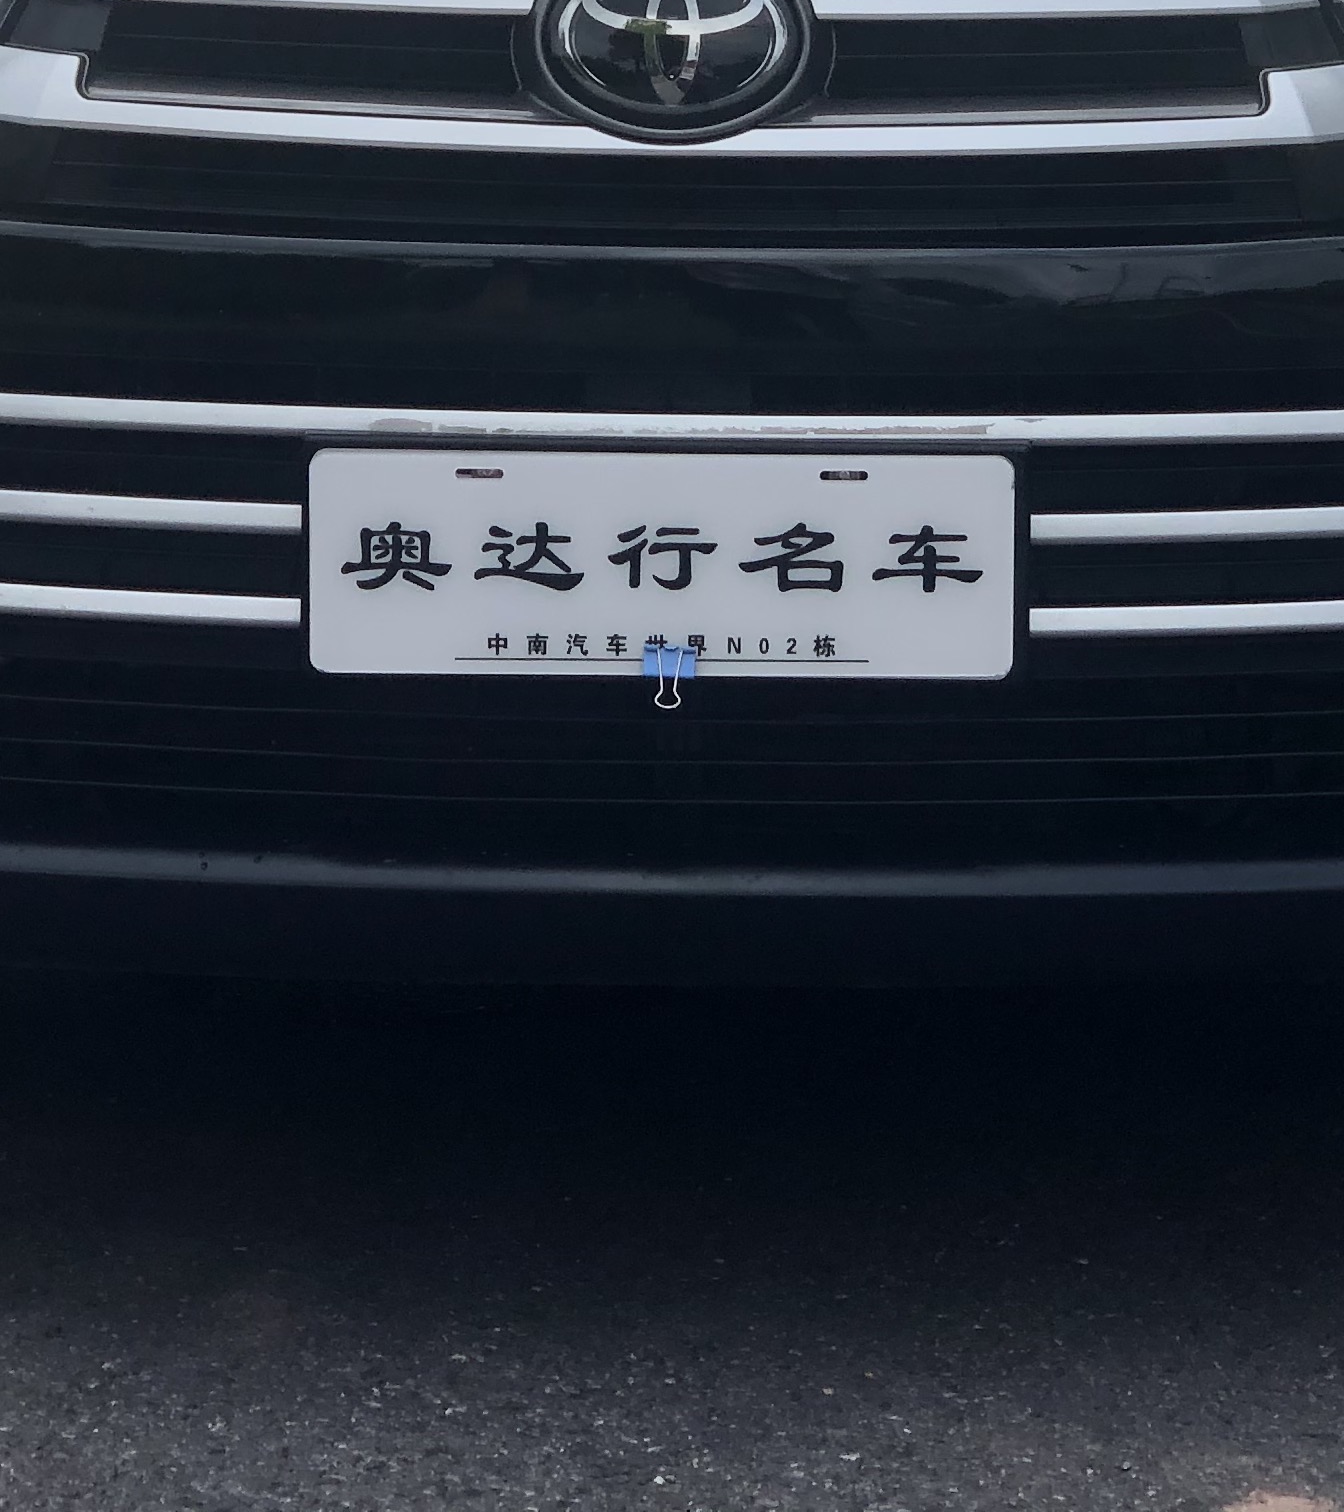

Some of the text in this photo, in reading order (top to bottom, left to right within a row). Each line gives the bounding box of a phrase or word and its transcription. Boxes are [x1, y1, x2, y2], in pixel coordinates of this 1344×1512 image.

[341, 522, 984, 593] 奥达行名车
